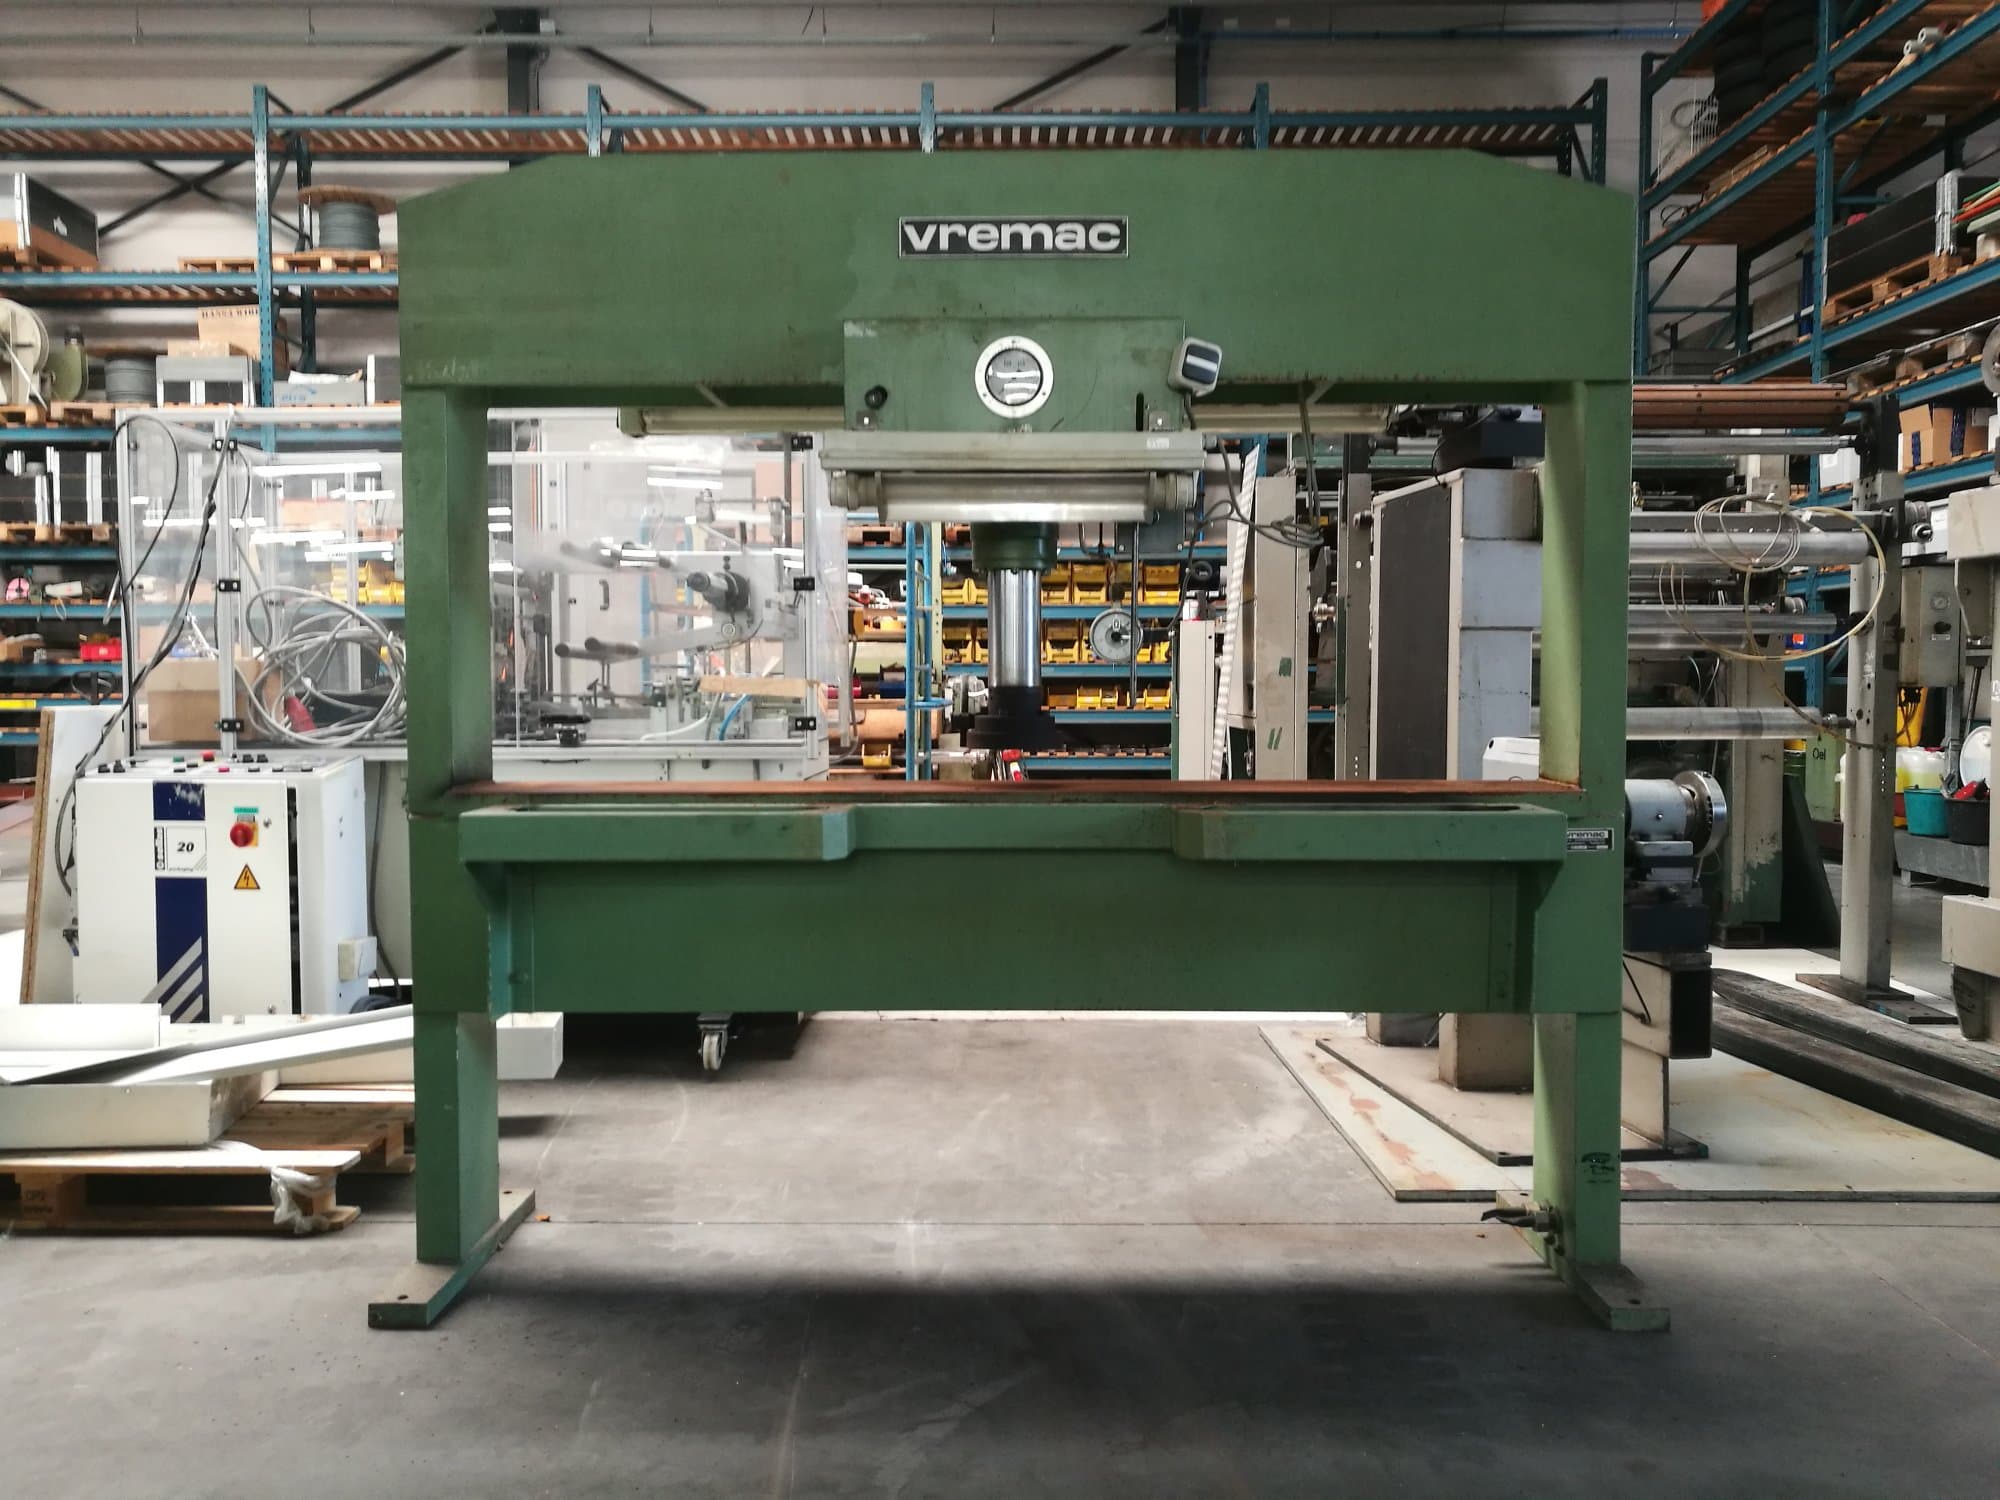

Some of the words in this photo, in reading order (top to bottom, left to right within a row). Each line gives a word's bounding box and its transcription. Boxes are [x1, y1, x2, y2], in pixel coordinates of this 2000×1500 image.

[903, 222, 1121, 251] vremac
[1812, 747, 1826, 760] Oel
[177, 842, 194, 852] 20
